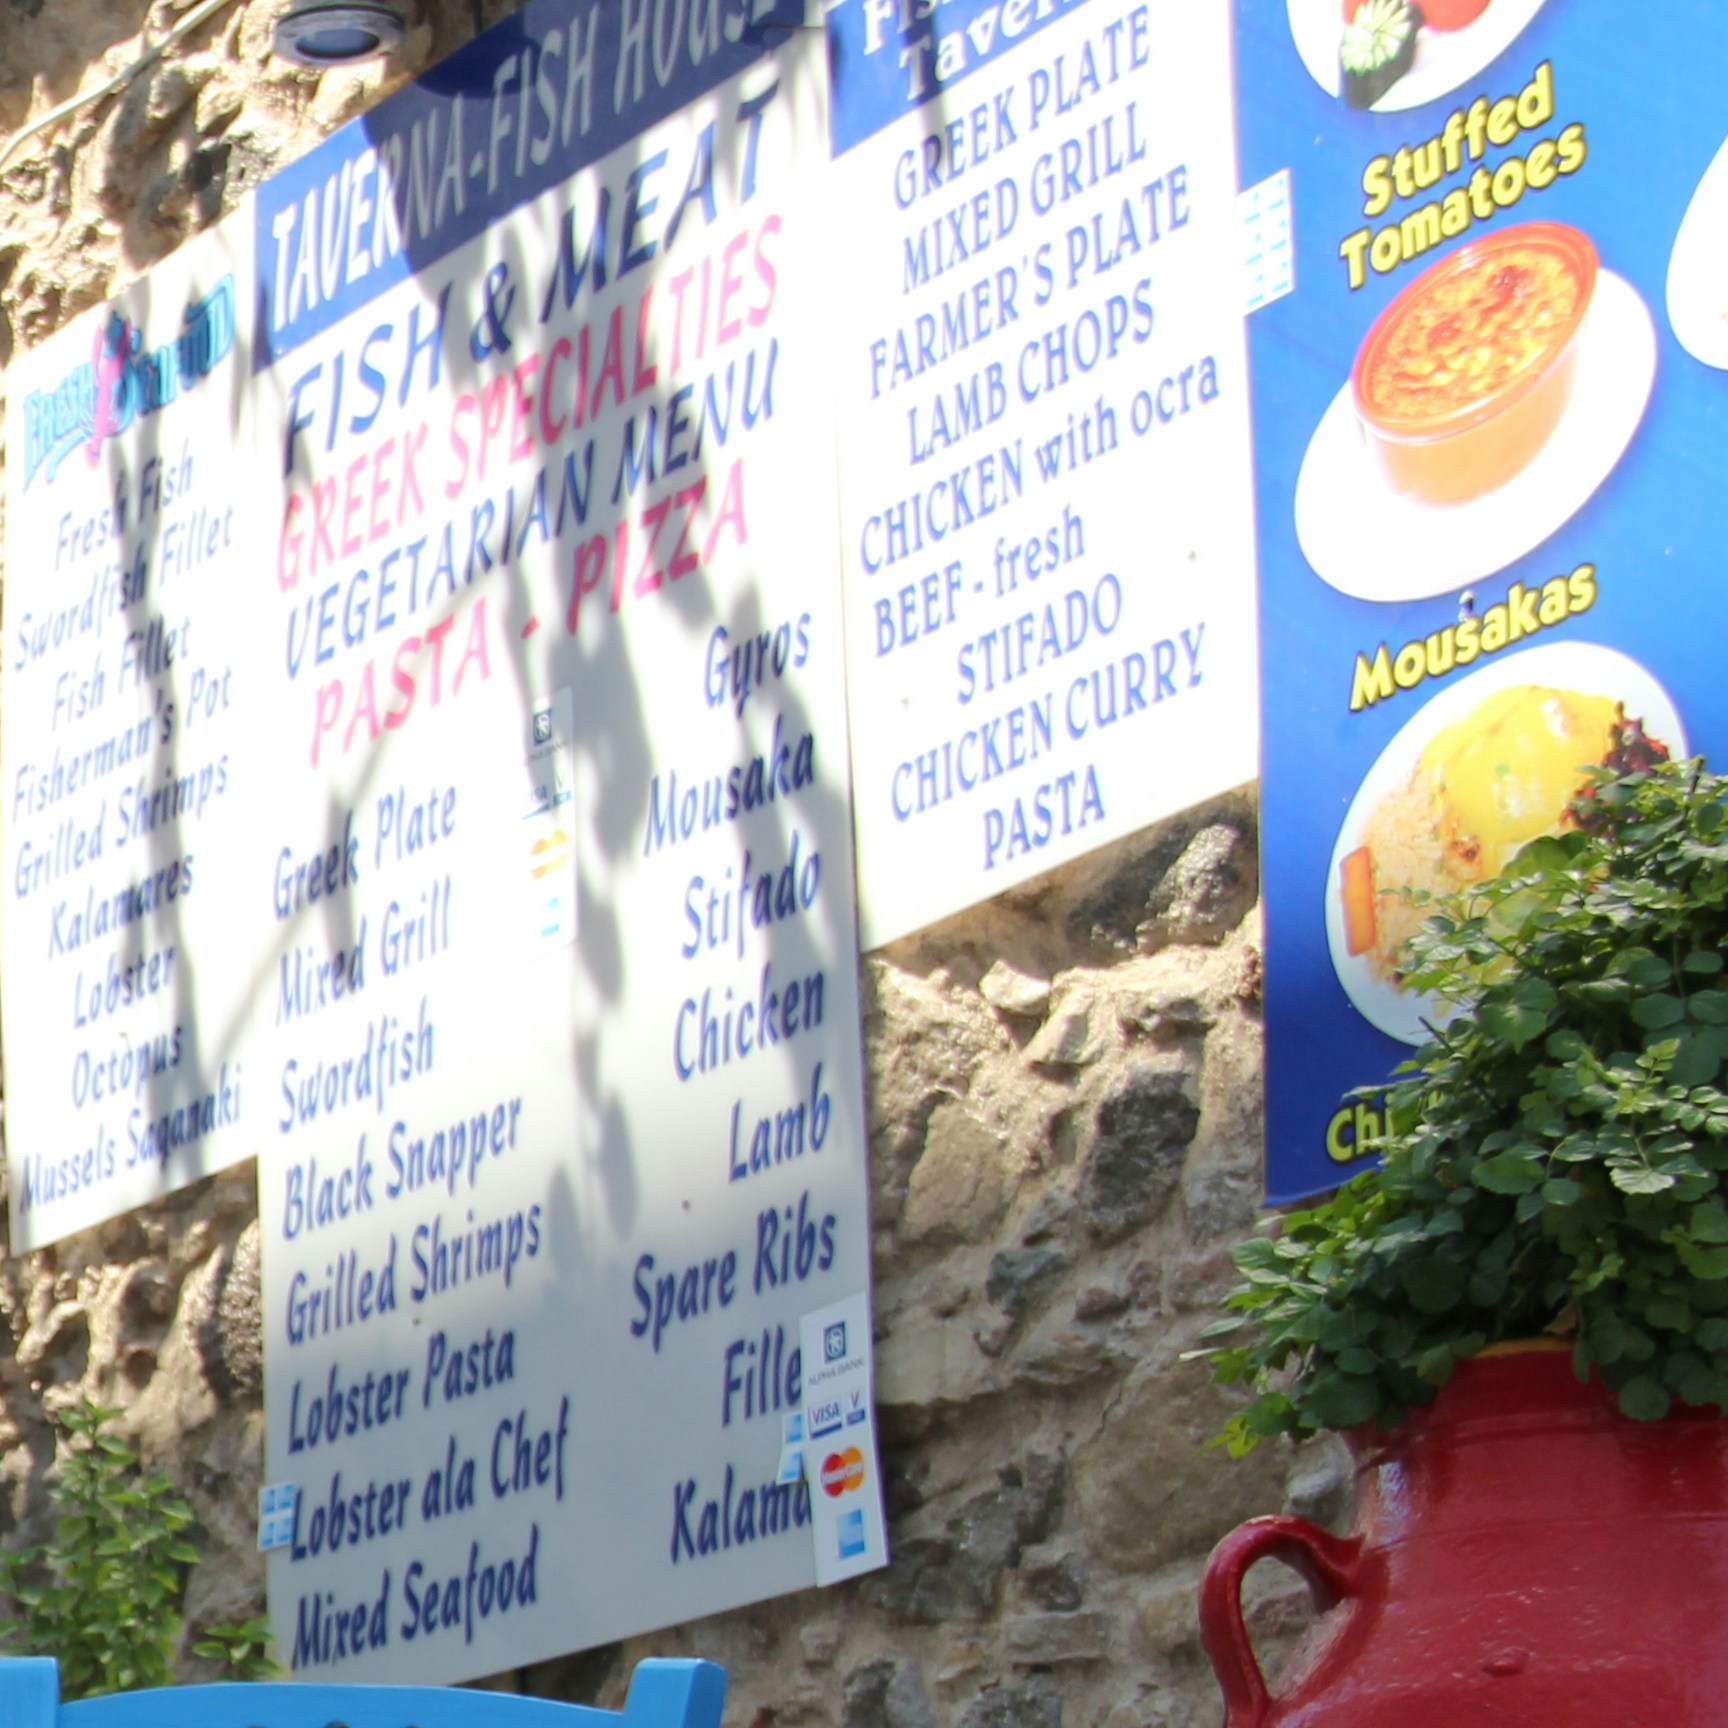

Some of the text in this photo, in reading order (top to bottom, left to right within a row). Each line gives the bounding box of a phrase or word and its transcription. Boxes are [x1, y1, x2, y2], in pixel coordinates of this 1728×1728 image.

[893, 4, 1152, 211] GREEK PLATE
[1360, 57, 1556, 218] Stuffed
[902, 100, 1149, 296] MIXED GRILL
[1338, 121, 1588, 292] Tomatoes
[283, 77, 780, 478] FISH & MEAT
[867, 162, 1193, 401] FARMER'S PLATE
[277, 213, 783, 594] GREEK SPECIALTIES
[906, 276, 1156, 466] LAMB CHOPS
[54, 437, 193, 573] Fresh Fish
[285, 337, 780, 681] VEGETARIAN MENU
[859, 352, 1220, 577] CHICKEN with ocra
[14, 505, 234, 673] Swordfish Fillet
[308, 596, 491, 770] PASTA
[566, 456, 749, 636] PIZZA
[872, 558, 964, 660] BEEF
[993, 502, 1086, 599] fresh
[955, 571, 1124, 706] STIFADO
[1347, 560, 1600, 716] Mousakas
[51, 613, 190, 732] Fish Fillet
[703, 612, 812, 720] Gyros
[889, 620, 1208, 824] CHICKEN CURRY
[12, 666, 232, 824] Fisherman's Pot
[643, 712, 816, 858] Mousaka
[981, 763, 1107, 873] PASTA
[14, 754, 230, 900] Grilled Shrimps
[273, 784, 458, 922] Greek Plate
[681, 829, 821, 961] Stifado
[47, 853, 196, 961] Kalamares
[275, 873, 452, 1029] Mixed Grill
[73, 943, 176, 1031] Lobster
[672, 960, 826, 1083] Chicken
[18, 1062, 243, 1215] Mussels Saganaki
[71, 1026, 183, 1111] Octopus
[278, 994, 434, 1135] Swordfish
[727, 1061, 833, 1184] Lamb
[281, 1096, 523, 1241] Black Snapper
[285, 1203, 543, 1348] Grilled Shrimps
[629, 1190, 838, 1355] Spare Ribs
[286, 1326, 516, 1457] Lobster Pasta
[720, 1325, 802, 1430] Fille
[812, 1401, 841, 1425] VISA
[290, 1395, 571, 1564] Lobster ala Chef
[669, 1462, 814, 1565] Kalama
[289, 1520, 541, 1673] Mixed Seafood
